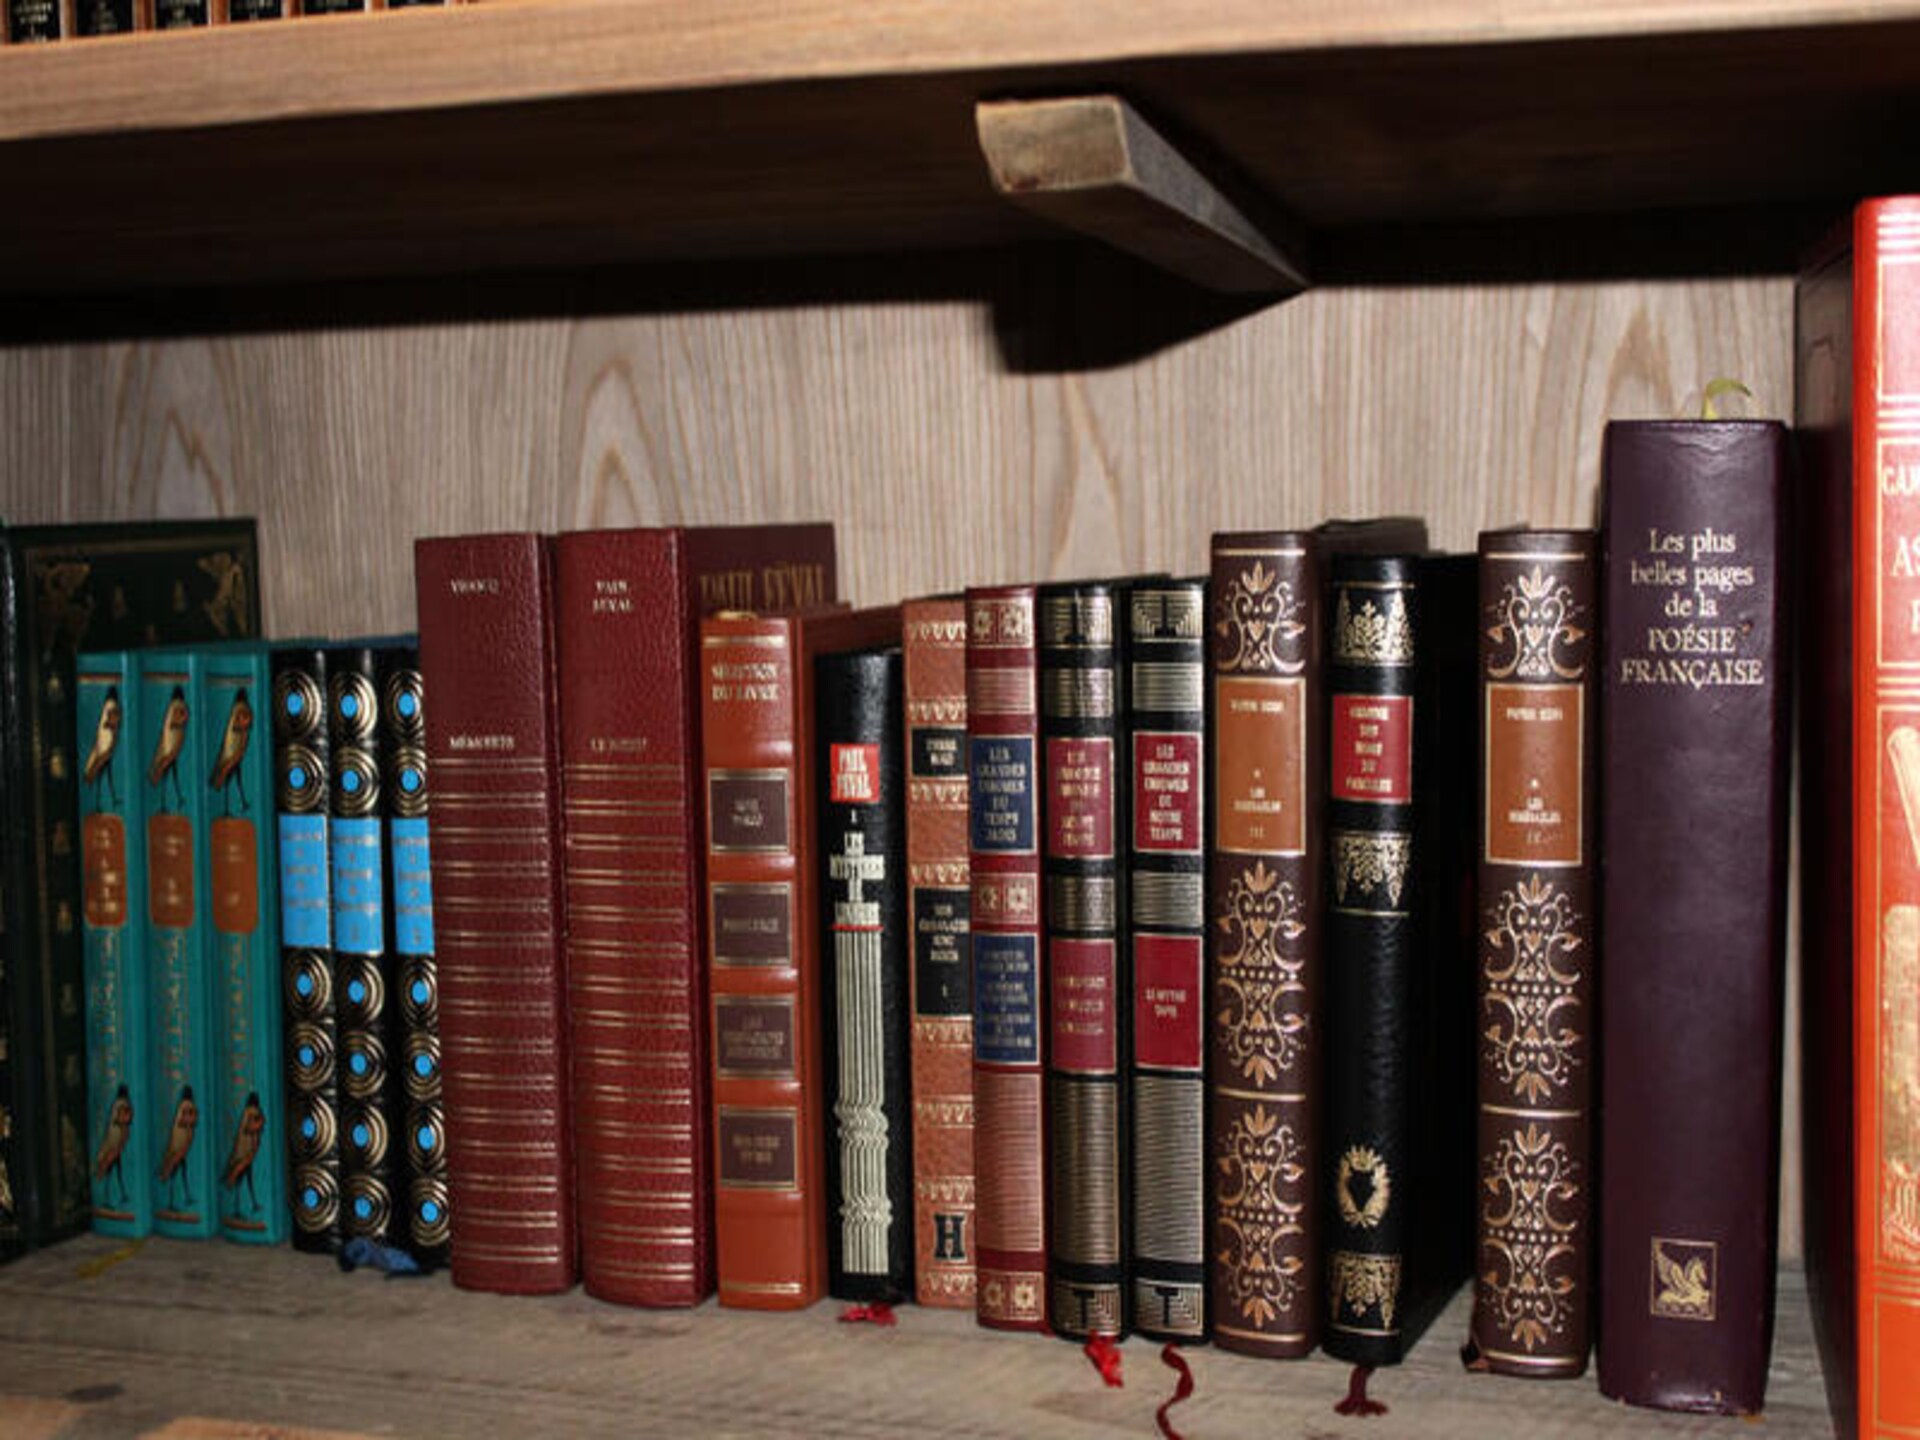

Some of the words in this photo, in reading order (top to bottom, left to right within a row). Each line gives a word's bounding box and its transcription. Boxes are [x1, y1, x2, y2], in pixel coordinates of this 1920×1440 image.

[1649, 528, 1684, 553] Les
[1691, 528, 1736, 559] plus
[1630, 560, 1687, 586] belles
[1693, 564, 1755, 593] pages
[1665, 592, 1692, 617] de
[1698, 592, 1718, 617] la
[1648, 622, 1737, 653] POÉSIE
[1620, 658, 1765, 690] FRANÇAISE
[932, 1212, 967, 1264] H
